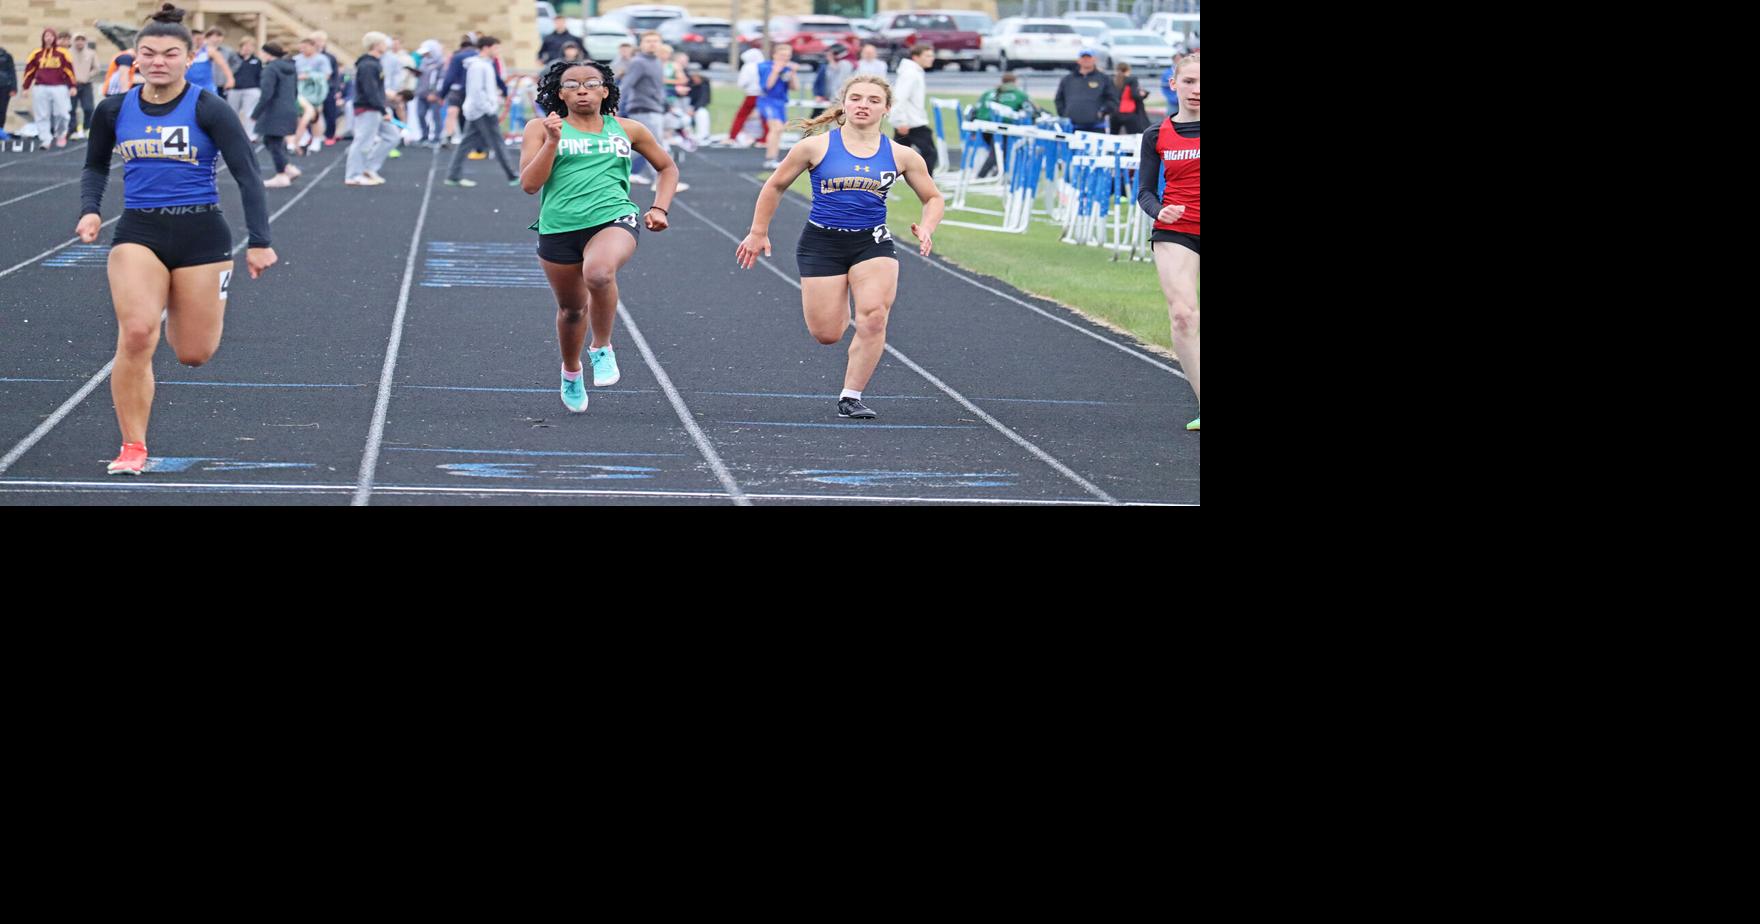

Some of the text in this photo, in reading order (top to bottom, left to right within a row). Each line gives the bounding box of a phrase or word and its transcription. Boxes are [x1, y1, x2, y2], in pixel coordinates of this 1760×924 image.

[163, 127, 188, 152] 4
[559, 138, 593, 155] PINE
[613, 136, 630, 155] 3
[112, 138, 199, 165] ATHEL
[820, 176, 885, 197] CATHEDR
[877, 172, 894, 191] 2
[160, 205, 207, 216] NIKE
